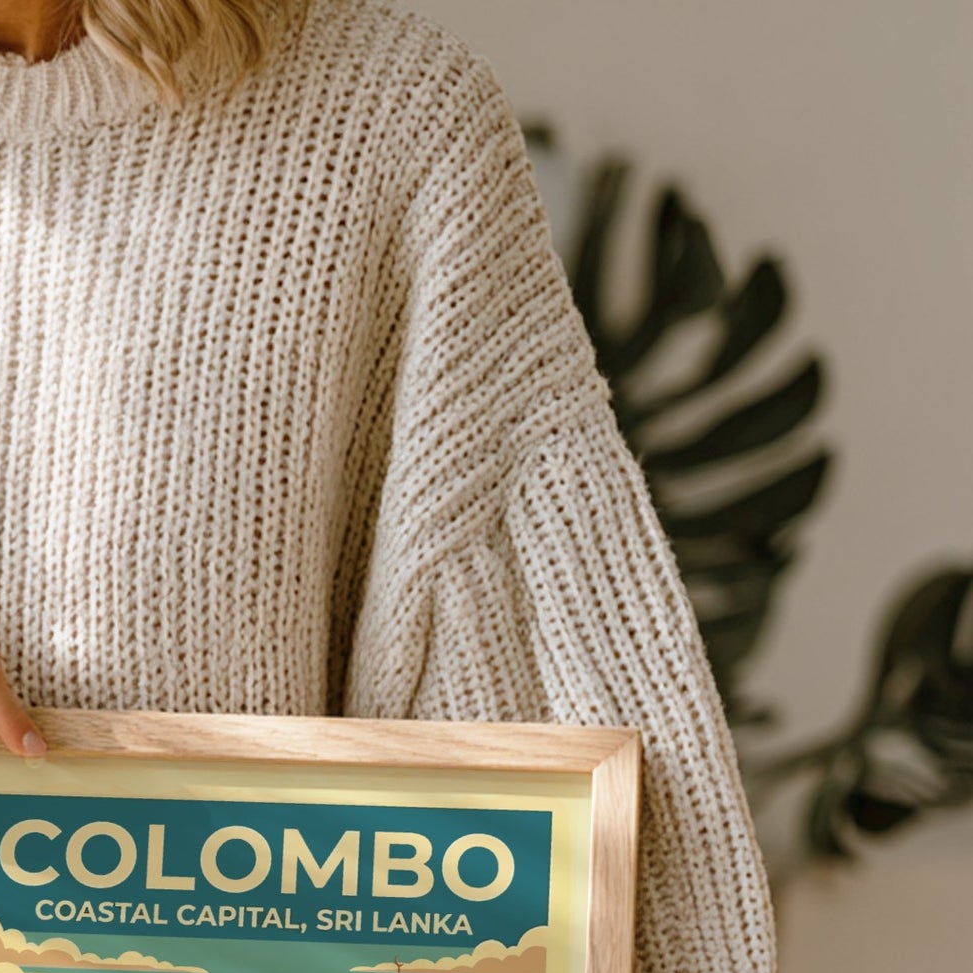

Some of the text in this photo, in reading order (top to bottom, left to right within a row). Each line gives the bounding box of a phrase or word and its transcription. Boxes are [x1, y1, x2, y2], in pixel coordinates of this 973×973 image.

[0, 818, 515, 901] COLOMBO
[35, 899, 473, 936] COASTAL CAPITAL, SRI LANKA
